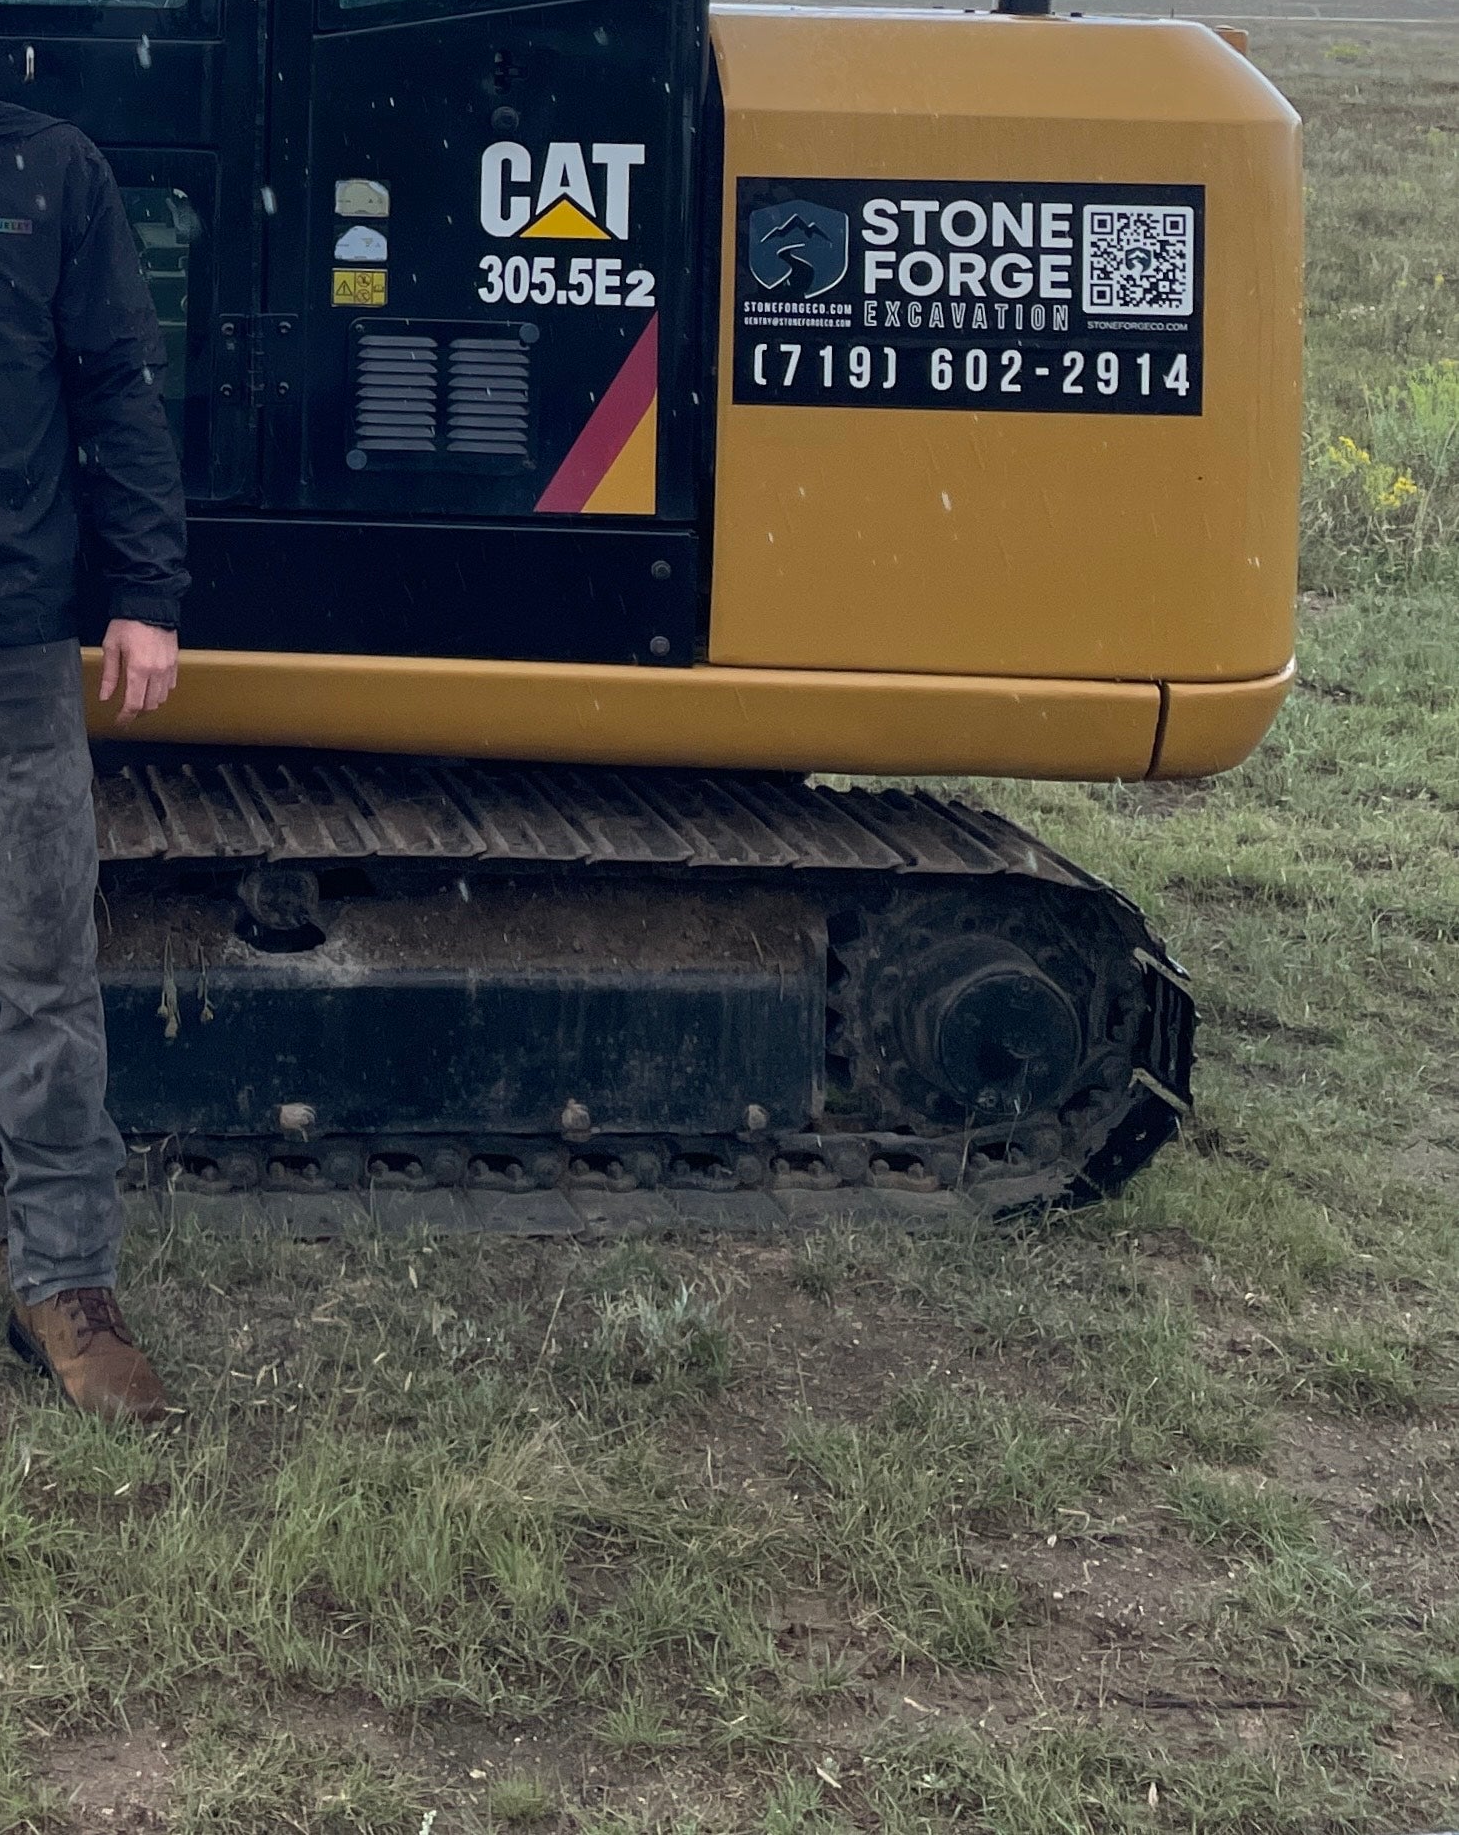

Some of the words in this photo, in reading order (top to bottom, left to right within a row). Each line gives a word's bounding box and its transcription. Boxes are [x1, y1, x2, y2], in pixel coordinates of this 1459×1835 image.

[480, 141, 646, 240] CAT
[861, 198, 1074, 249] STONE
[477, 254, 656, 307] 305.5E2
[863, 249, 1073, 299] FORGE
[743, 300, 853, 316] STONEFORGECO.COM
[863, 300, 1070, 332] EXCAVATION
[1086, 320, 1189, 332] STONEFORGECO.COM
[753, 342, 898, 389] (719)
[930, 348, 1191, 397] 602-2914
